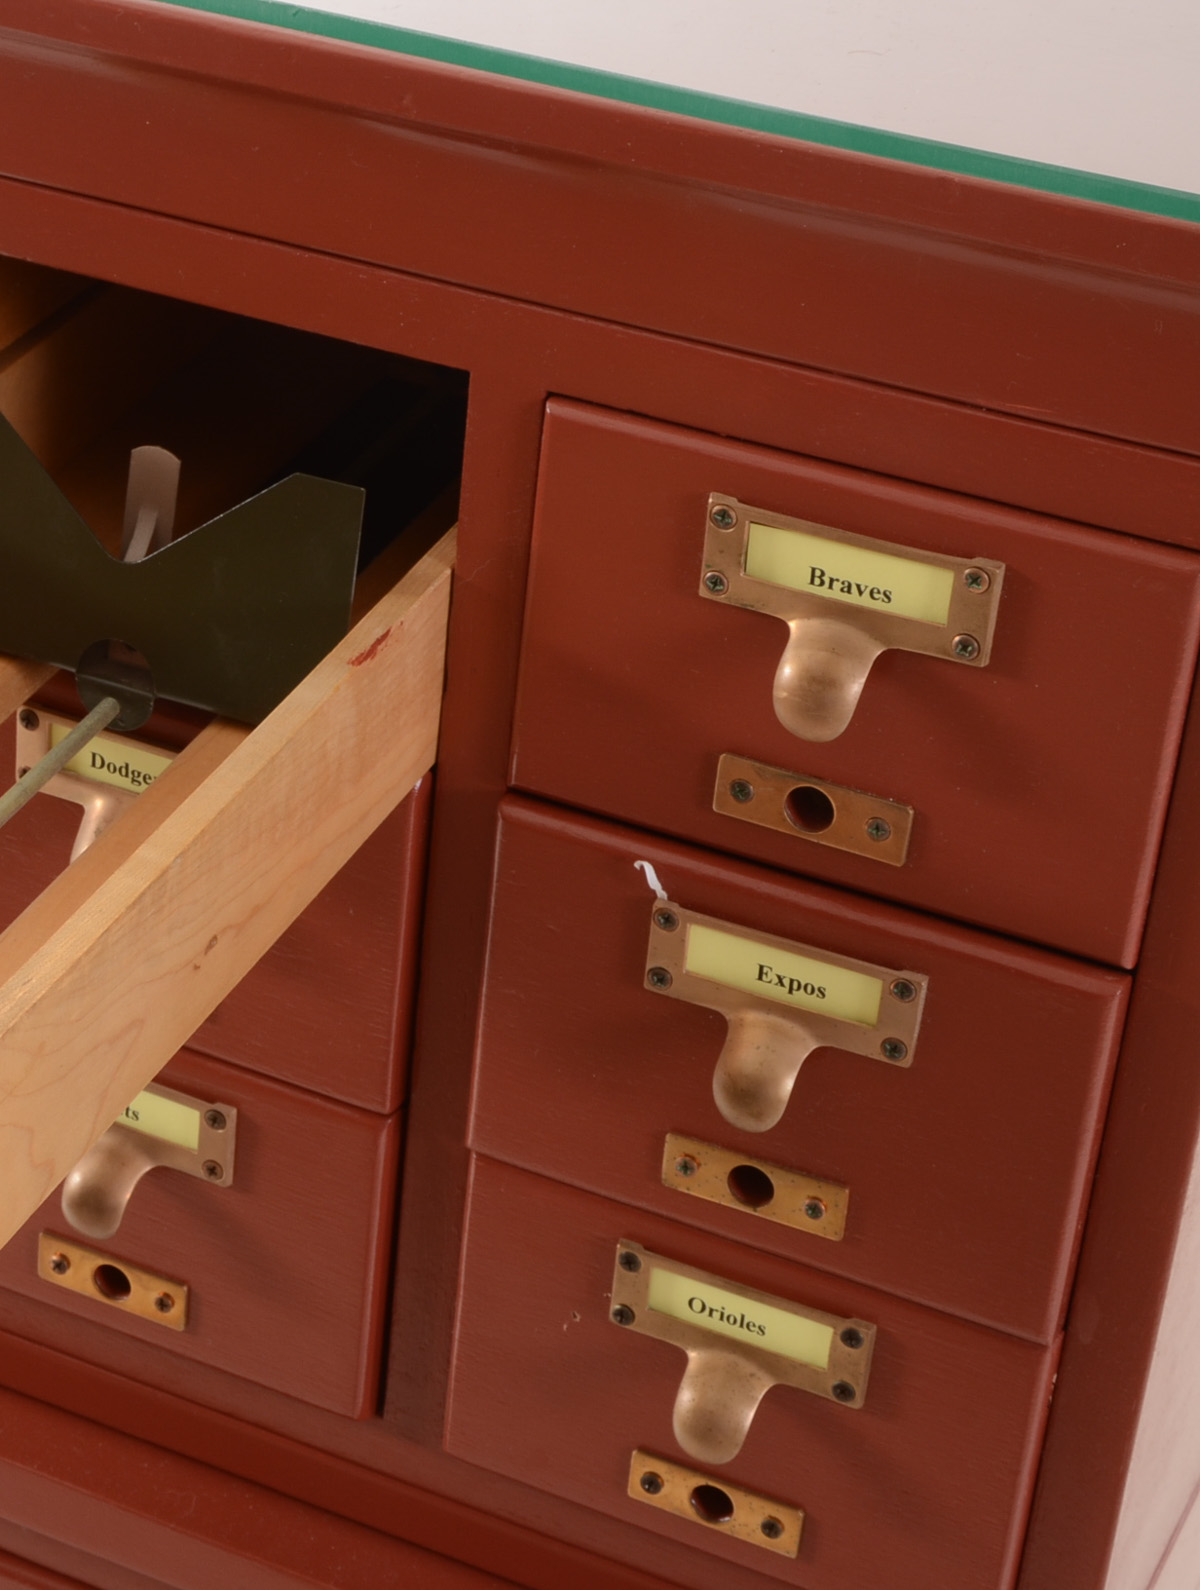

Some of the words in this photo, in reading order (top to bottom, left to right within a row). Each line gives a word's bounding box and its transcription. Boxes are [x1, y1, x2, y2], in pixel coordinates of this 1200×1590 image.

[808, 566, 893, 604] Braves
[90, 751, 157, 787] Dodge
[756, 963, 827, 1000] Expos
[687, 1296, 767, 1337] Orioles
